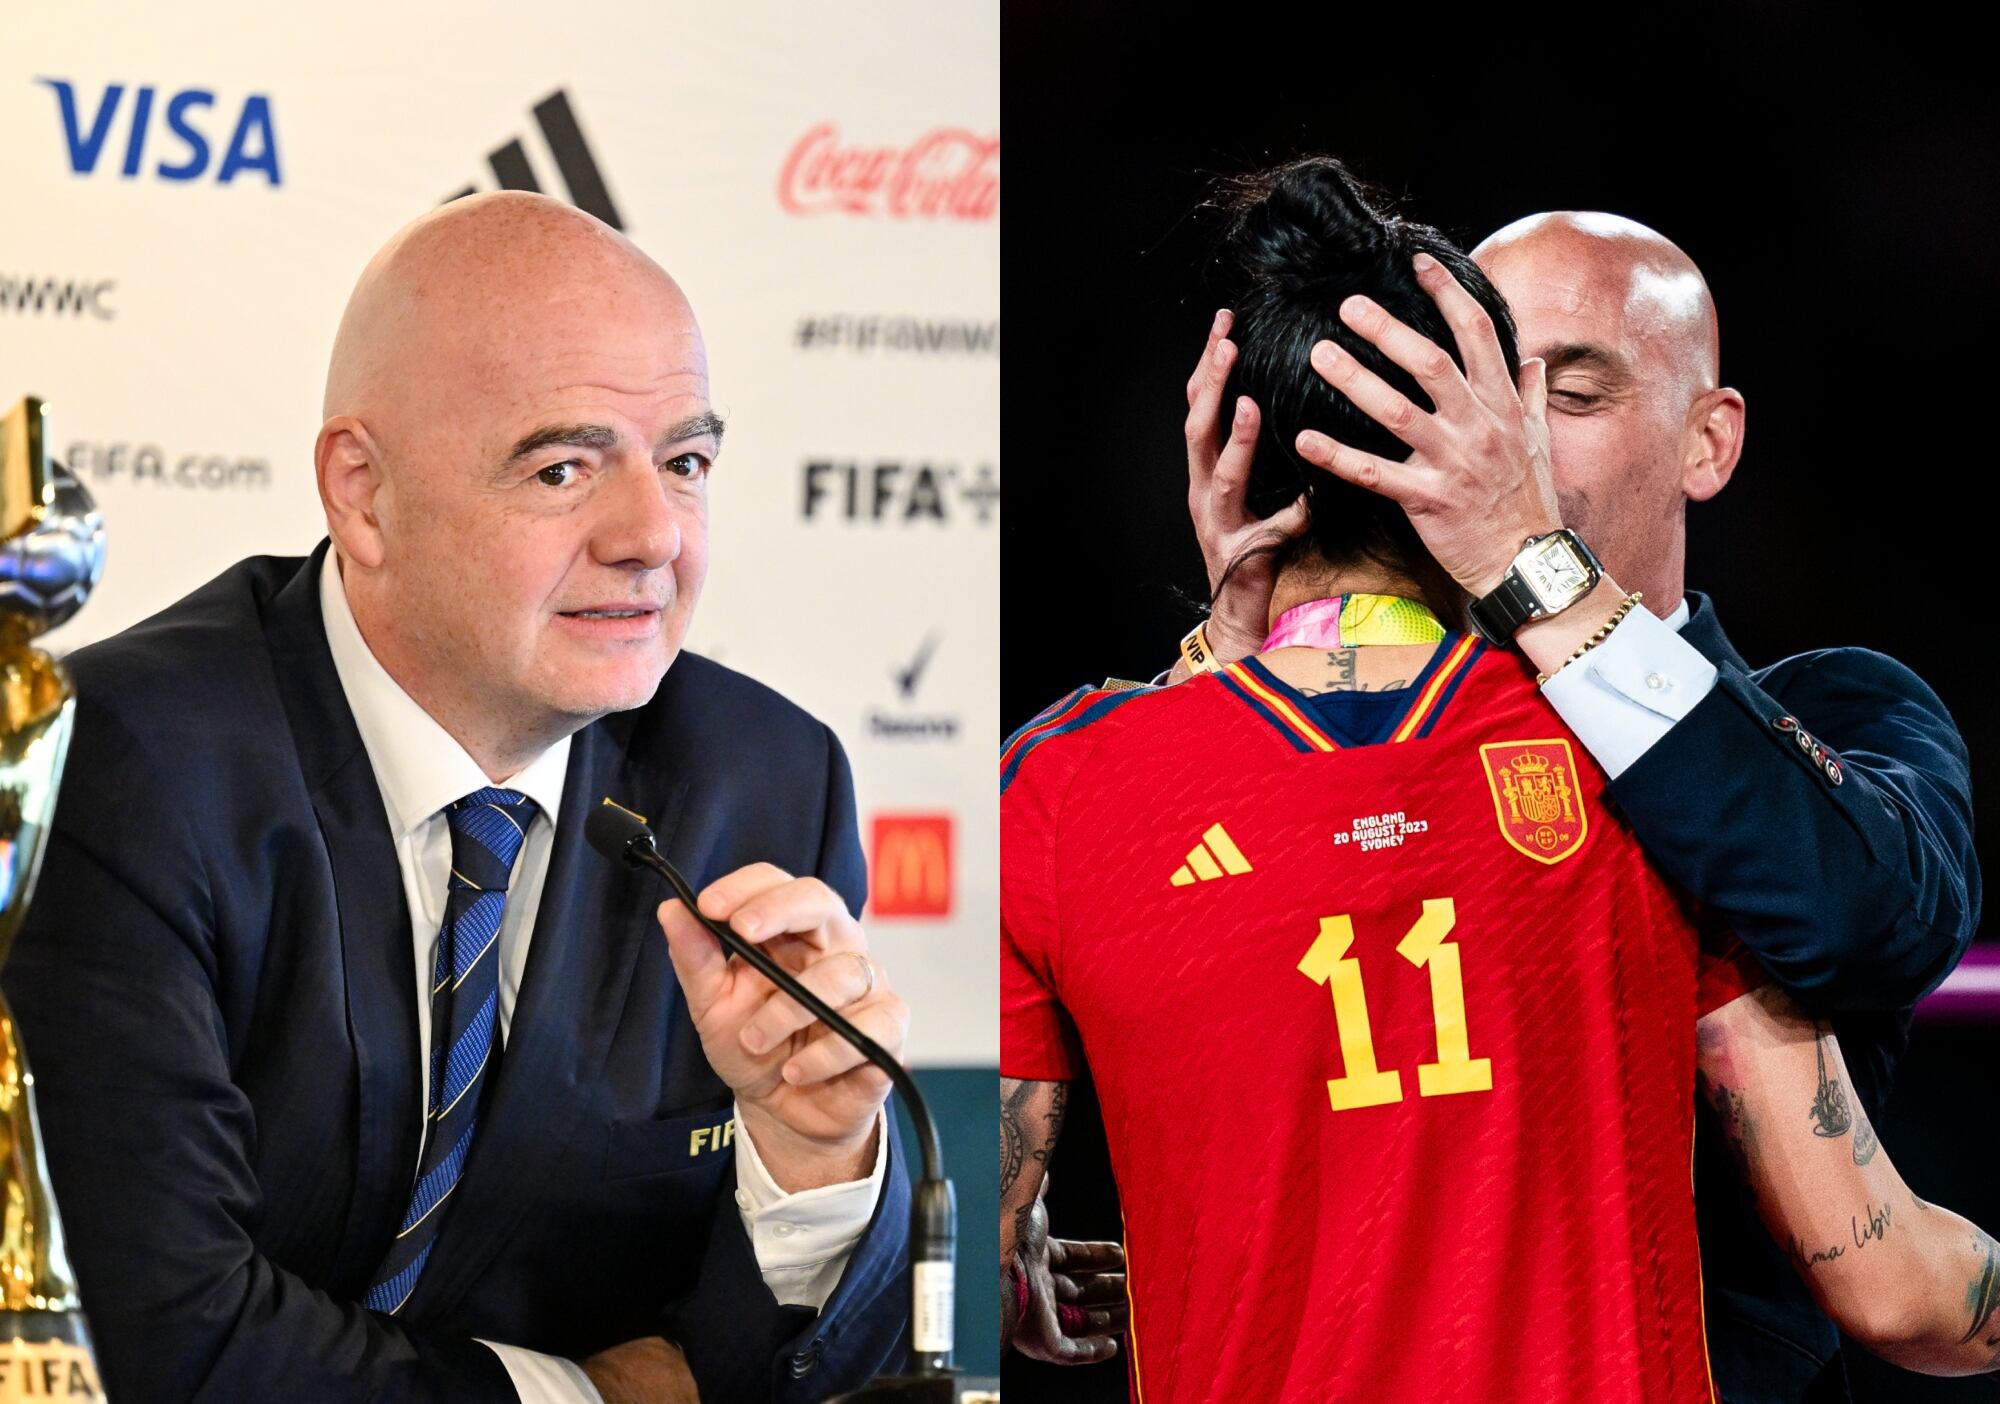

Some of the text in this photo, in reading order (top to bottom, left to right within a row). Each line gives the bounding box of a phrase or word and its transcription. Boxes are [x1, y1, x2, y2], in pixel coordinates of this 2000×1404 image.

[34, 76, 282, 187] VISA
[1333, 820, 1428, 845] 20 AUGUST 2023
[1352, 811, 1406, 831] ENGLAND
[1360, 834, 1404, 852] SYDNEY
[1296, 897, 1493, 1112] 11
[690, 1119, 736, 1156] FIF
